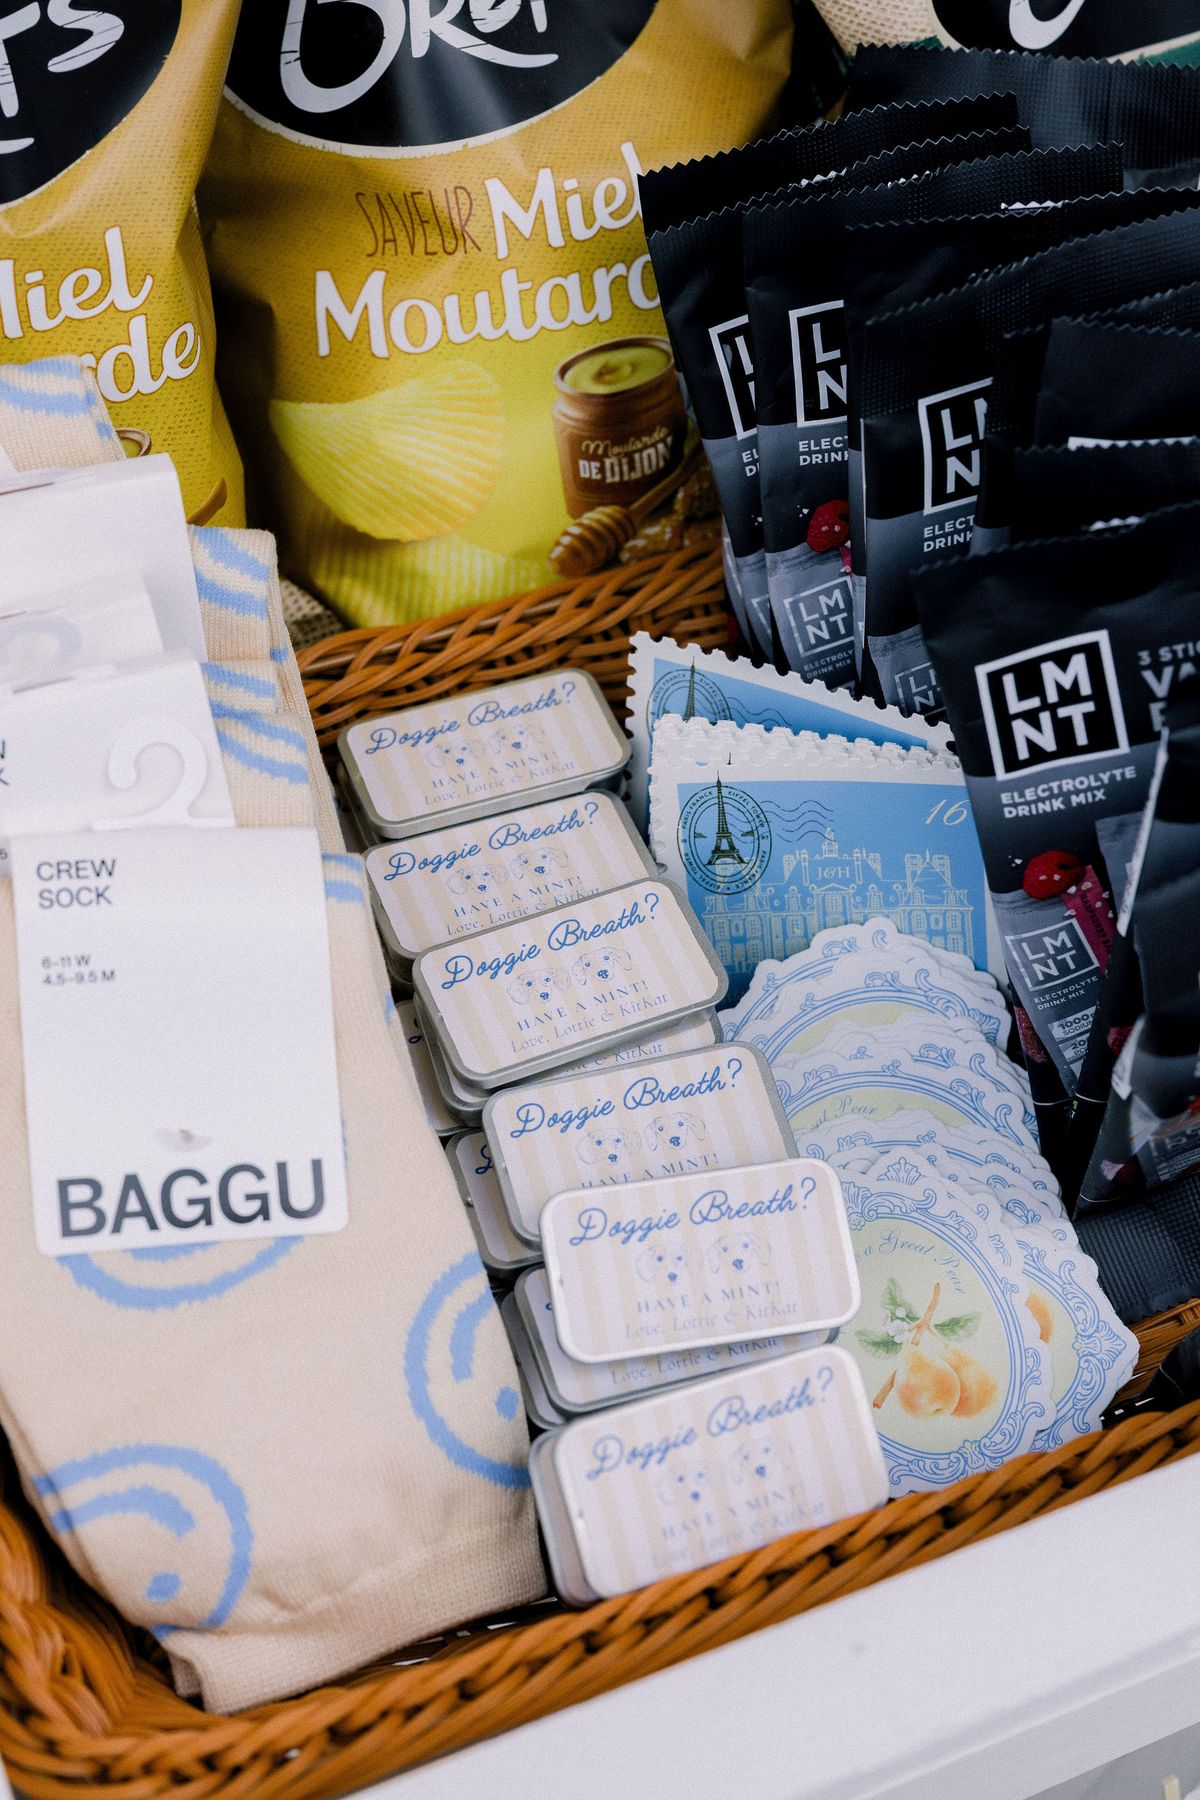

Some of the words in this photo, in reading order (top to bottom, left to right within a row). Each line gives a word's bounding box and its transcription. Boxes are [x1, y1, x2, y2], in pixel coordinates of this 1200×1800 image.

[355, 186, 482, 257] SAVEUR
[80, 313, 200, 403] de
[578, 459, 601, 480] DE
[604, 436, 673, 484] DIJON
[1137, 649, 1152, 666] 3
[1002, 652, 1093, 715] LM
[365, 719, 461, 754] Doggie
[468, 682, 576, 727] Breath?
[1010, 701, 1096, 761] NT
[432, 765, 480, 789] HAVE
[488, 765, 500, 776] A
[1000, 766, 1137, 805] ELECTROLYTE
[689, 790, 714, 811] FRANCE
[728, 790, 751, 807] EIFFEL
[750, 805, 766, 828] TOWER
[925, 798, 971, 827] 16
[1003, 798, 1066, 819] DRINK
[1069, 789, 1107, 808] MIX
[384, 844, 481, 881] Doggie
[488, 801, 599, 850] Breath?
[36, 859, 117, 881] CREW
[38, 884, 113, 909] SOCK
[454, 896, 503, 919] HAVE
[511, 892, 523, 903] A
[528, 875, 583, 898] MINT!
[445, 919, 485, 937] Love,
[488, 905, 531, 925] Lottie
[75, 953, 91, 966] W
[441, 944, 541, 990] Doggie
[547, 893, 659, 951] Breath?
[101, 969, 116, 982] M
[1033, 975, 1099, 1004] ELECTROLYTE
[516, 1006, 568, 1032] HAVE
[576, 1001, 588, 1012] A
[594, 978, 650, 1006] MINT!
[1037, 997, 1067, 1010] DRINK
[1068, 989, 1086, 1001] MIX
[510, 1033, 550, 1054] Love,
[554, 1015, 597, 1040] Lottie
[620, 992, 669, 1017] KitKat
[510, 1098, 616, 1139] Doggie
[623, 1058, 742, 1111] Breath?
[643, 1167, 655, 1181] A
[661, 1152, 720, 1177] MINT!
[57, 1158, 326, 1238] BAGGU
[569, 1206, 681, 1247] Doggie
[689, 1176, 817, 1225] Breath?
[879, 1228, 936, 1255] Great
[637, 1293, 691, 1315] HAVE
[702, 1292, 713, 1304] A
[720, 1280, 781, 1301] MINT!
[586, 1425, 698, 1480] Doggie
[706, 1366, 834, 1437] Breath?
